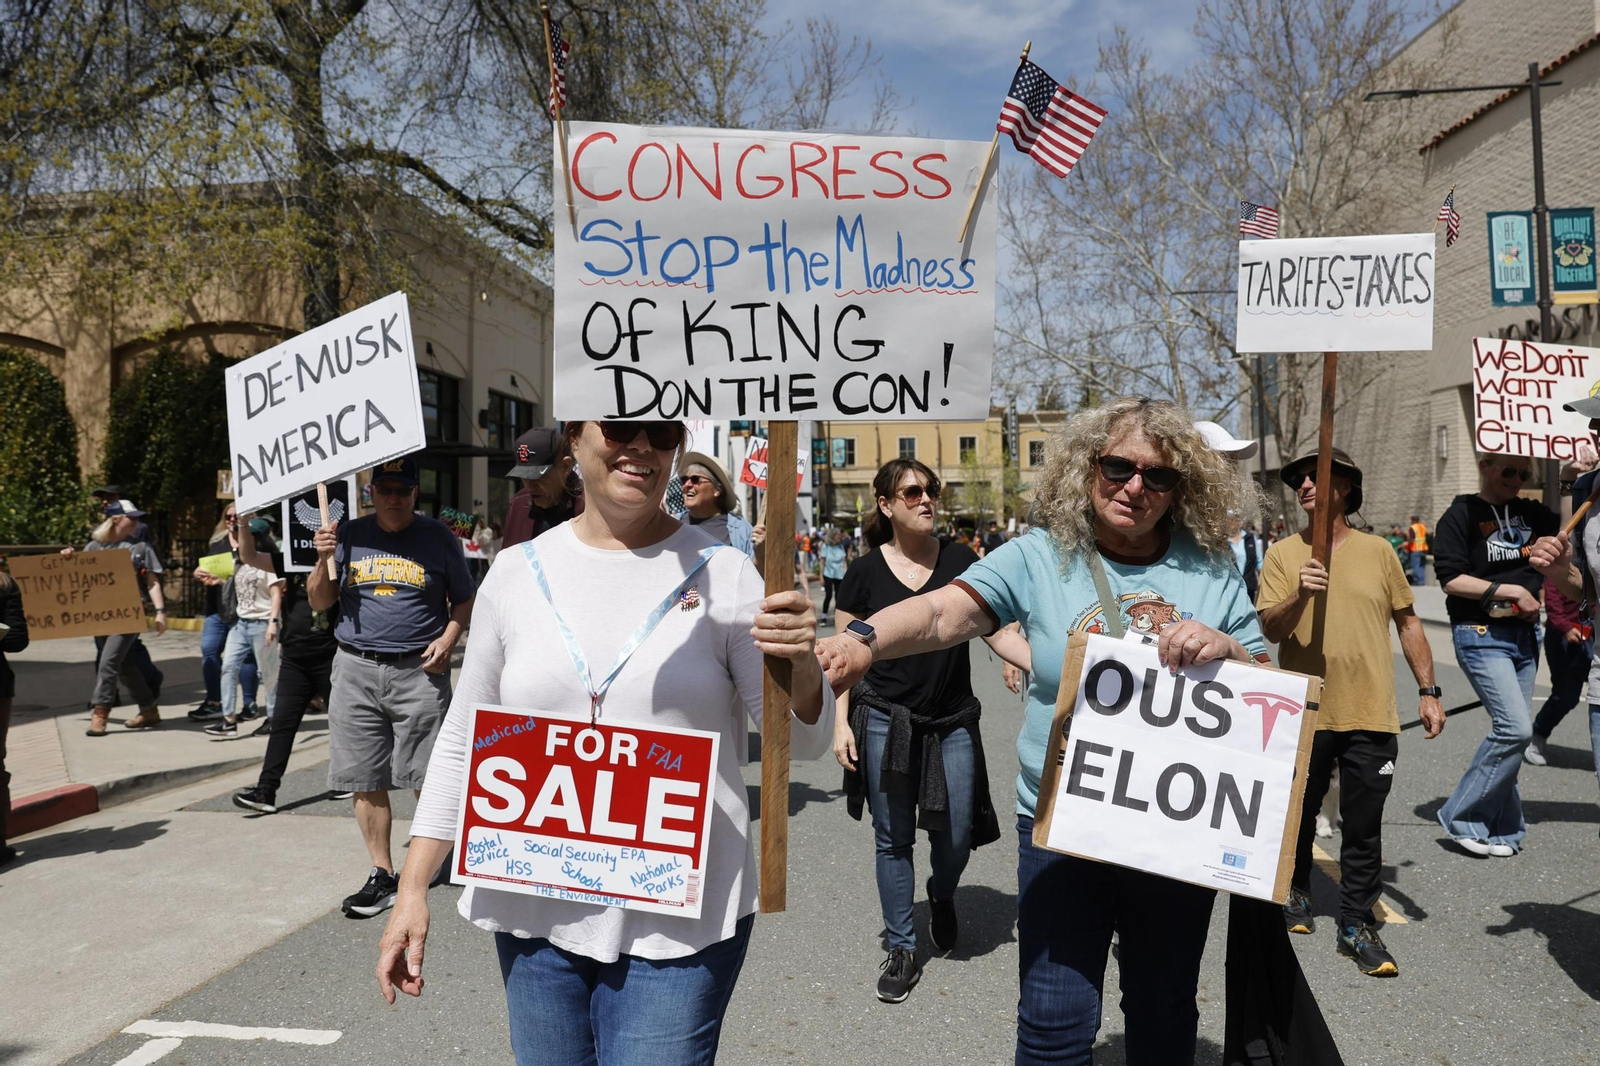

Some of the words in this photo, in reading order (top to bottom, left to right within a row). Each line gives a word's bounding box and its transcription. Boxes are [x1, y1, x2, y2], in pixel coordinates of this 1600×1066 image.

[572, 132, 953, 201] CONGRESS
[1554, 217, 1591, 237] WALNUT
[580, 219, 740, 293] Stop
[748, 219, 829, 294] the
[835, 213, 977, 290] Madness
[1241, 252, 1432, 310] TARIFFS=TAXES
[1499, 265, 1526, 283] LOCAL
[683, 299, 886, 366] KING
[244, 312, 403, 420] DE-MUSK
[1473, 338, 1522, 372] We
[594, 365, 712, 418] DON
[719, 371, 818, 416] THE
[832, 341, 955, 415] CON!
[1476, 394, 1553, 425] Him
[237, 398, 396, 497] AMERICA
[300, 539, 317, 549] DIS
[15, 574, 63, 595] TINY
[69, 571, 116, 589] HANDS
[347, 558, 425, 590] CALIFORNIA
[56, 589, 91, 605] OFF
[61, 607, 141, 626] DEMOCRACY
[474, 715, 536, 752] Medicaid
[545, 724, 639, 767] FOR
[646, 742, 682, 772] FAA
[471, 756, 700, 848] SALE
[1066, 739, 1264, 838] ELON
[466, 833, 503, 855] Postal
[467, 847, 510, 867] Service
[523, 839, 563, 859] Social
[565, 845, 617, 872] Security
[620, 847, 646, 862] EPA
[505, 859, 533, 877] HSS
[561, 861, 603, 892] Schools
[629, 856, 682, 888] National
[532, 884, 558, 899] THE
[559, 887, 630, 908] ENVIRONMENT
